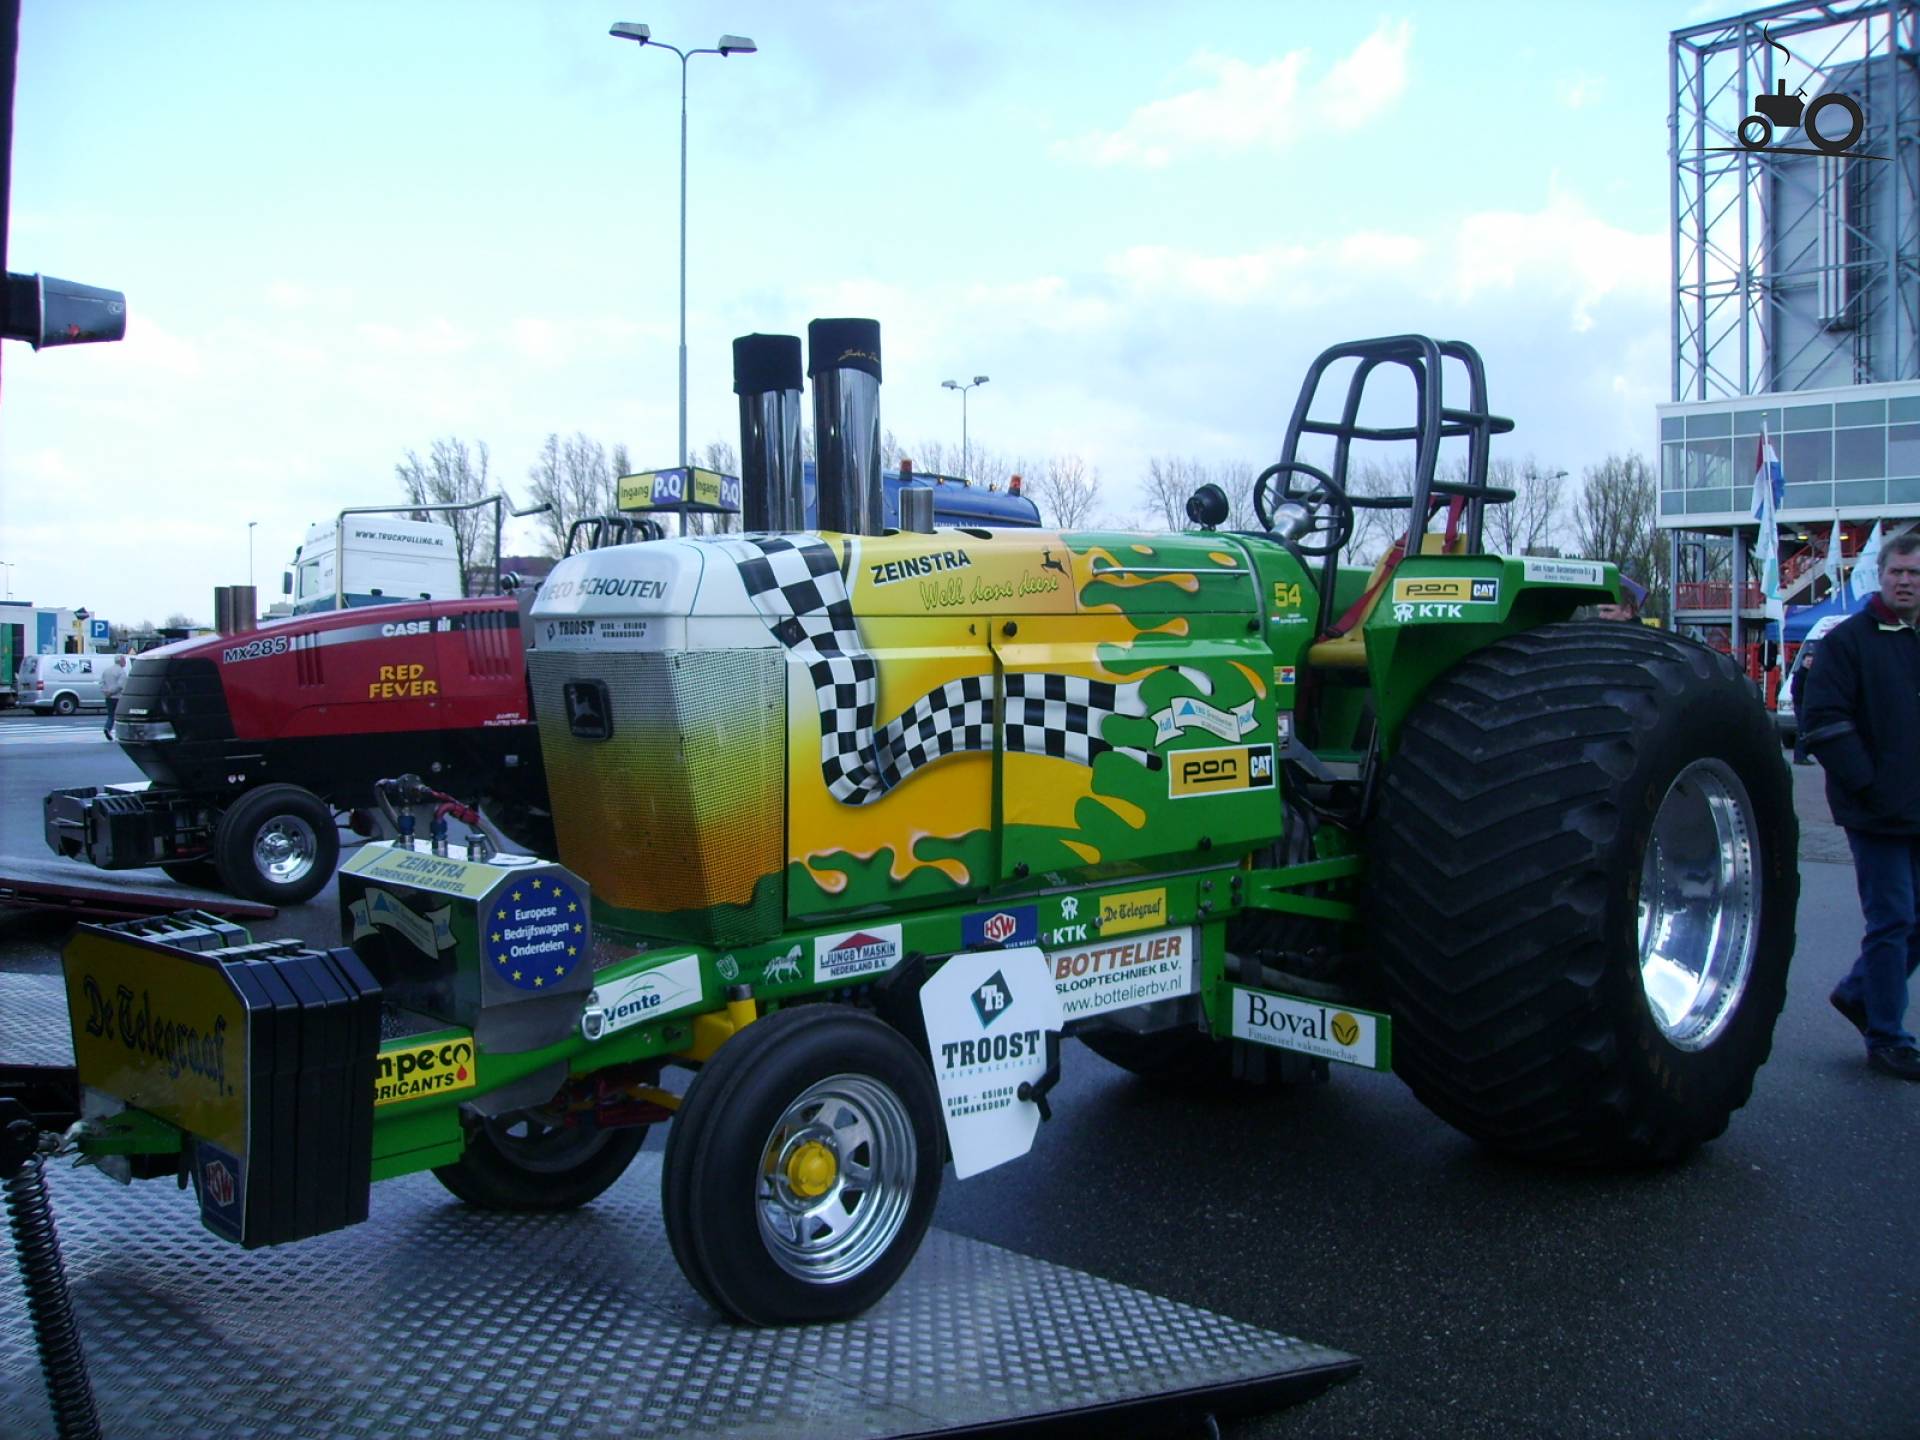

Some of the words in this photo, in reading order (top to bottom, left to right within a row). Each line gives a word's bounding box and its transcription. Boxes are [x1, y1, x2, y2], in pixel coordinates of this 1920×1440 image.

[355, 530, 444, 546] WWW.TRUCKPULLING.NL
[870, 549, 972, 585] ZEINSTRA
[576, 577, 668, 600] SCHOUTEN
[919, 577, 965, 610] Well
[1273, 582, 1302, 608] 54
[1406, 583, 1459, 596] pon
[1473, 583, 1496, 597] CAT
[1419, 604, 1463, 618] KTK
[95, 622, 105, 636] P
[381, 620, 431, 637] CASE
[223, 635, 287, 664] MX285
[379, 664, 424, 681] RED
[369, 680, 438, 699] FEVER
[1183, 758, 1237, 784] pon
[1250, 755, 1272, 778] CAT
[397, 856, 467, 878] ZEINSTRA
[515, 905, 557, 922] Europese
[1104, 908, 1119, 922] De
[1119, 898, 1162, 920] Telegraaf
[504, 921, 569, 941] Bedrijfswagen
[985, 914, 1016, 940] HSW
[1053, 924, 1087, 944] KTK
[510, 940, 565, 957] Onderdelen
[1055, 935, 1182, 980] BOTTELIER
[831, 960, 873, 976] NEDERLAND
[1055, 965, 1157, 994] SLOOPTECHNIEK
[1160, 960, 1182, 973] B.V.
[1247, 993, 1328, 1041] Boval
[942, 1029, 1040, 1069] TROOST
